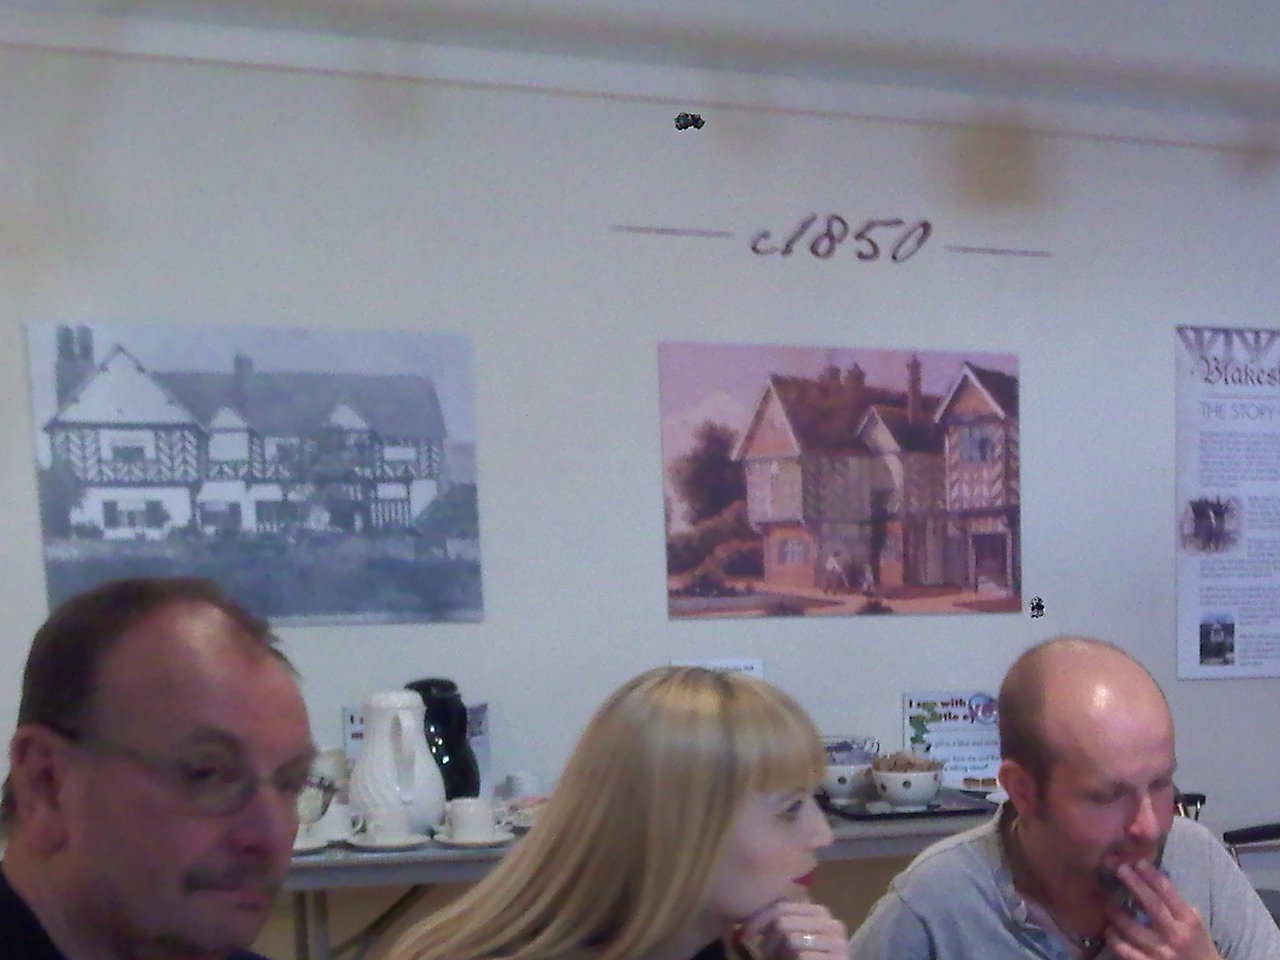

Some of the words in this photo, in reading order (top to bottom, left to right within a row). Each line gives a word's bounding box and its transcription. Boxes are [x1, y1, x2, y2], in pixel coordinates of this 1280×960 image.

[749, 213, 932, 263] c1850
[1201, 402, 1225, 418] THE
[1231, 403, 1272, 419] STORY
